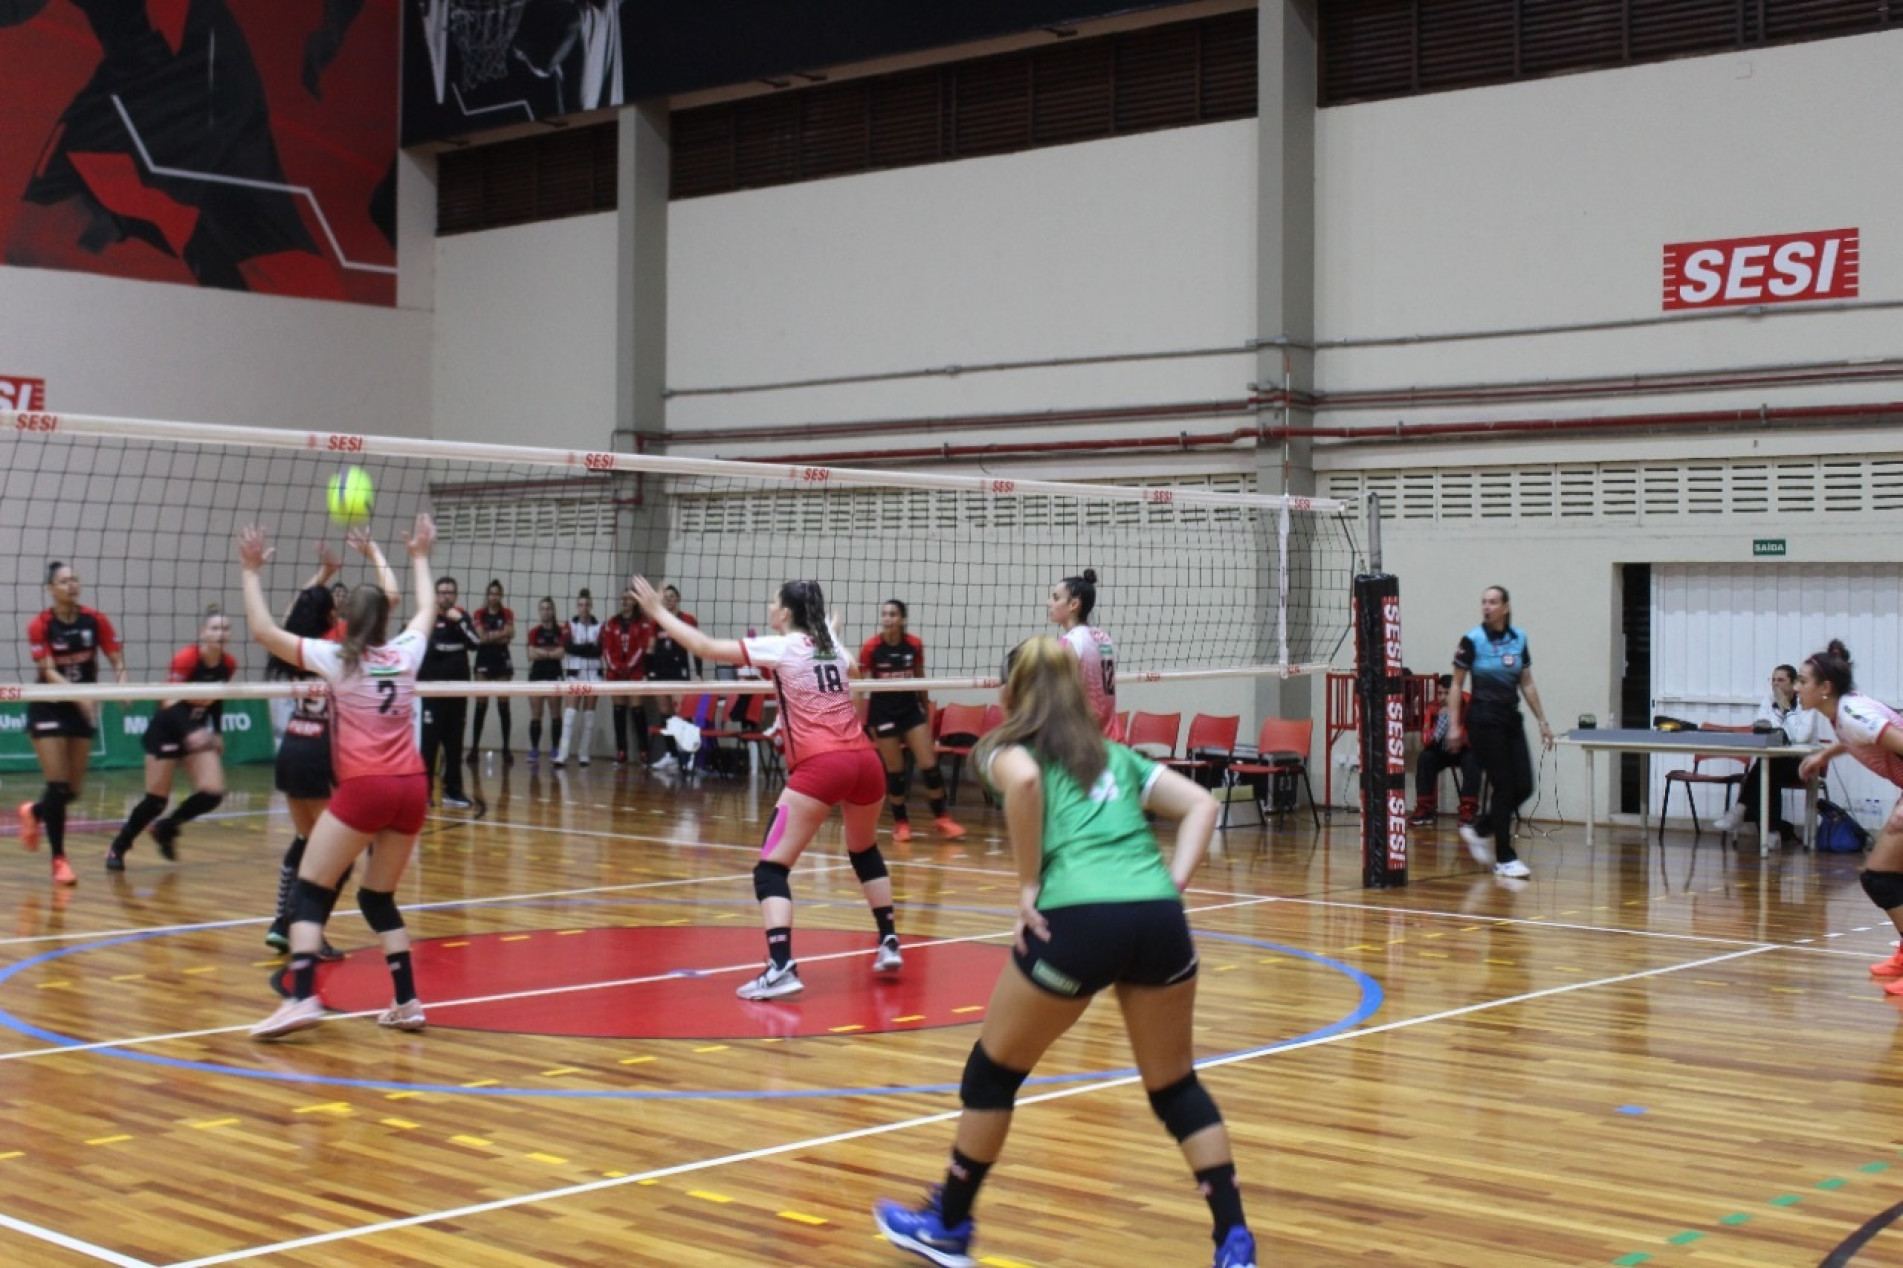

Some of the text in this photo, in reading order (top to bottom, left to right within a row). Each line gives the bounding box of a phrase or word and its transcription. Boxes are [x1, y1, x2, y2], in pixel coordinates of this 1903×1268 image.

[1679, 239, 1840, 303] SESI
[16, 413, 58, 431] SESI
[327, 435, 363, 451] SESI
[584, 453, 615, 468] SESI
[803, 467, 829, 481] SESI
[992, 480, 1015, 493] SESI
[1384, 604, 1401, 672] SESI
[813, 664, 844, 693] 18
[1387, 701, 1405, 767] SESI
[1388, 796, 1406, 863] SESI
